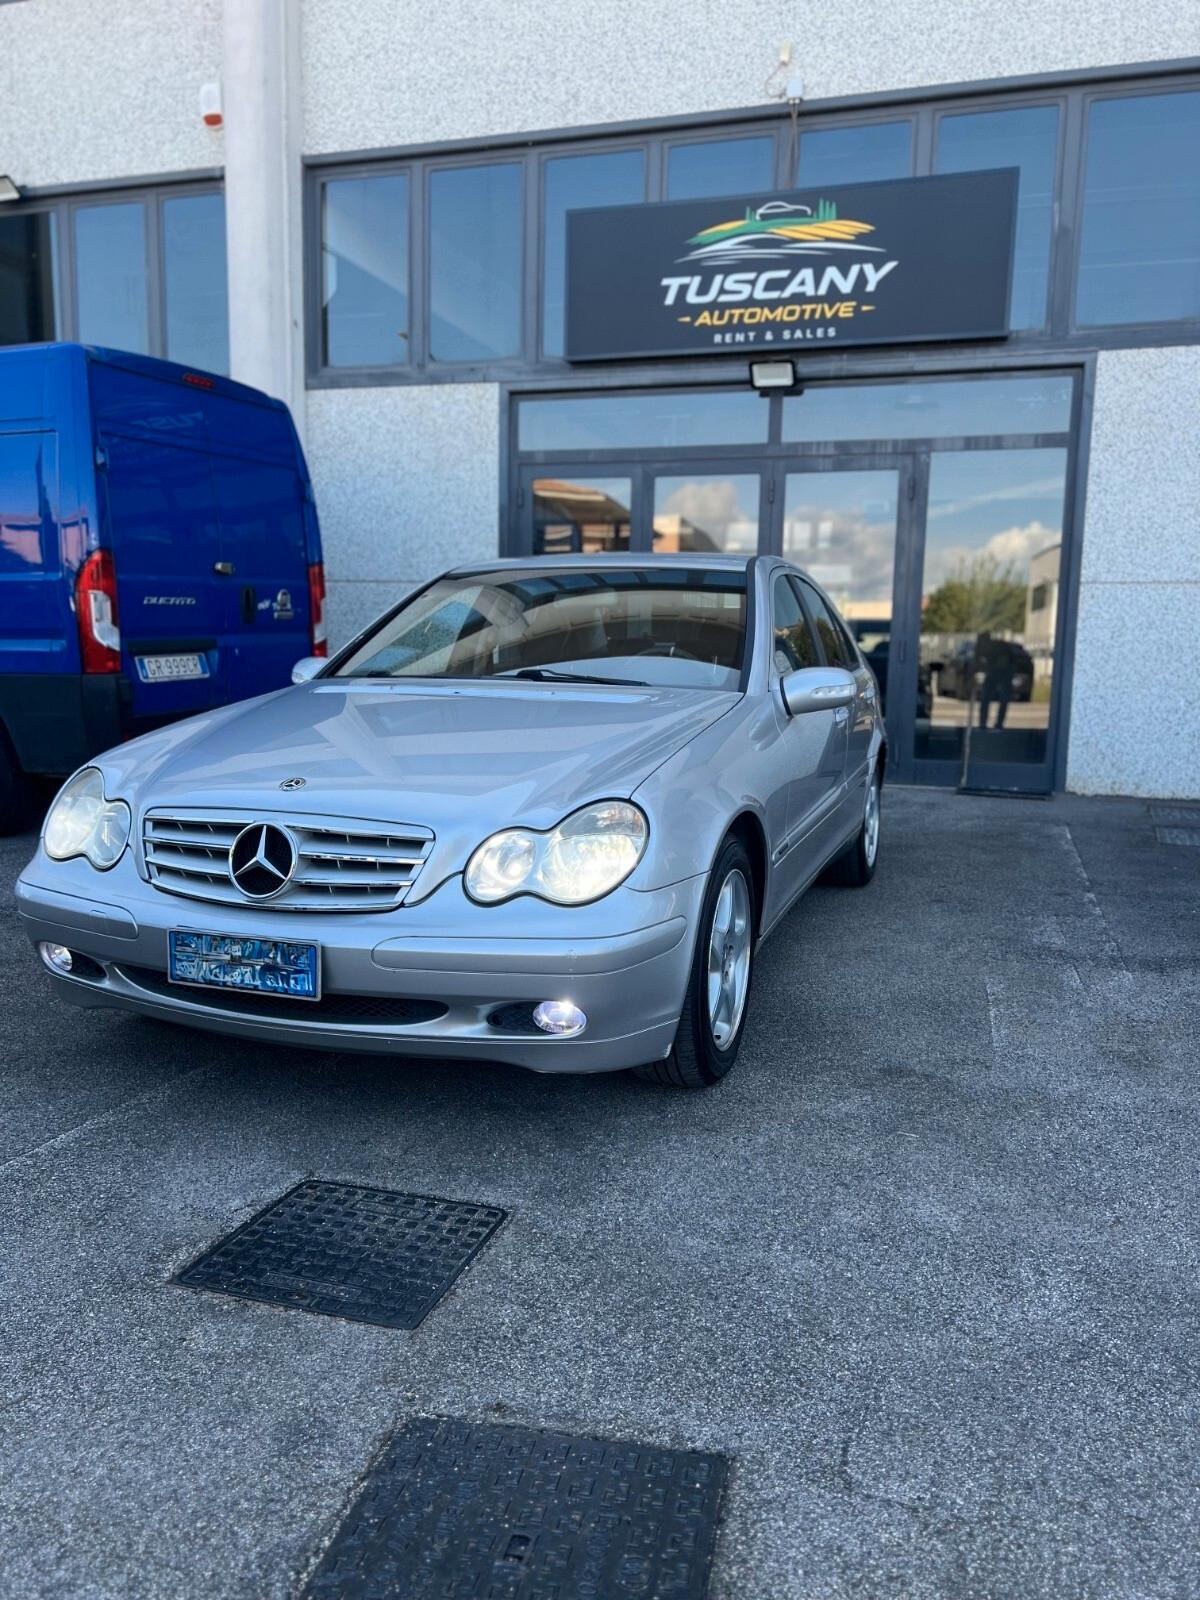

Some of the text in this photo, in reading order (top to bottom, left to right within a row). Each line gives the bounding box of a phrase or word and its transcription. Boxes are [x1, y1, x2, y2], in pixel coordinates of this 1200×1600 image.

[660, 260, 899, 306] TUSCANY
[694, 301, 857, 327] AUTOMOTIVE
[713, 327, 837, 344] RENT & SALES
